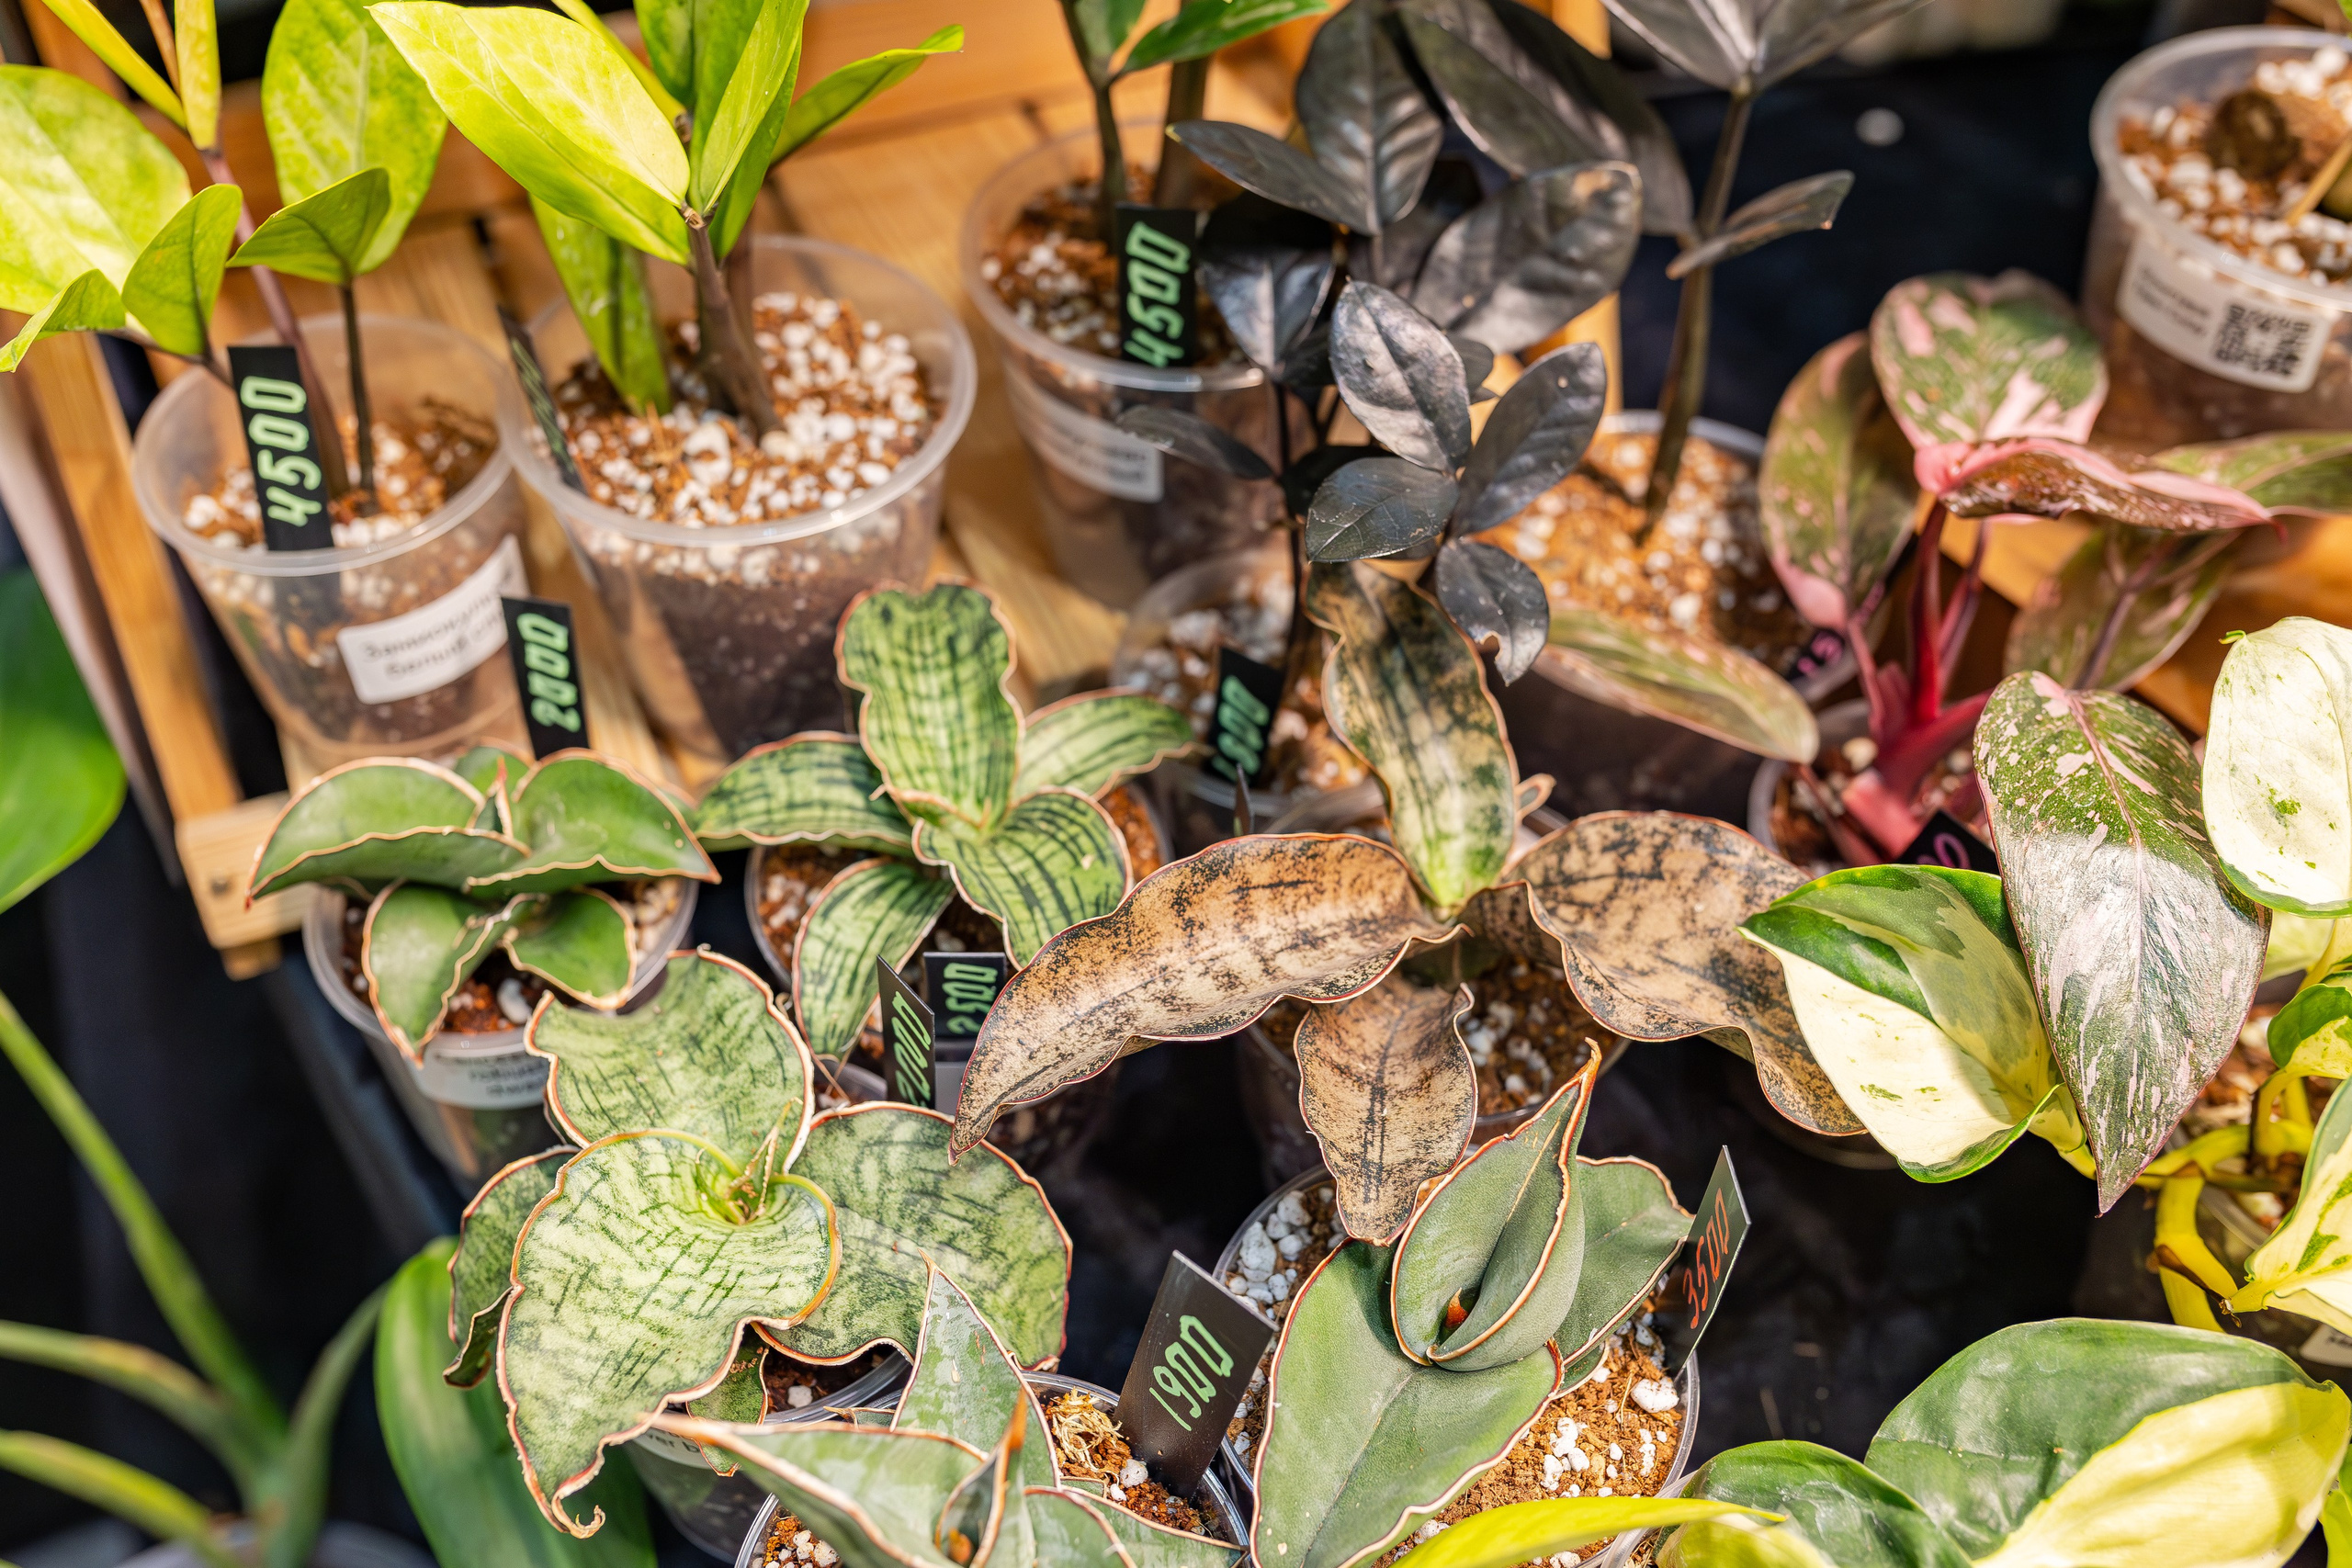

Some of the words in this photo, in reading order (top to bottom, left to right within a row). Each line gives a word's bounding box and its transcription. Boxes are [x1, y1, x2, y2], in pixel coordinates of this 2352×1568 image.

[1124, 220, 1192, 367] 4500
[240, 376, 322, 527] 4500
[516, 612, 582, 733] 2000
[1682, 1187, 1730, 1330] 3500
[1148, 1314, 1235, 1432] 1900
